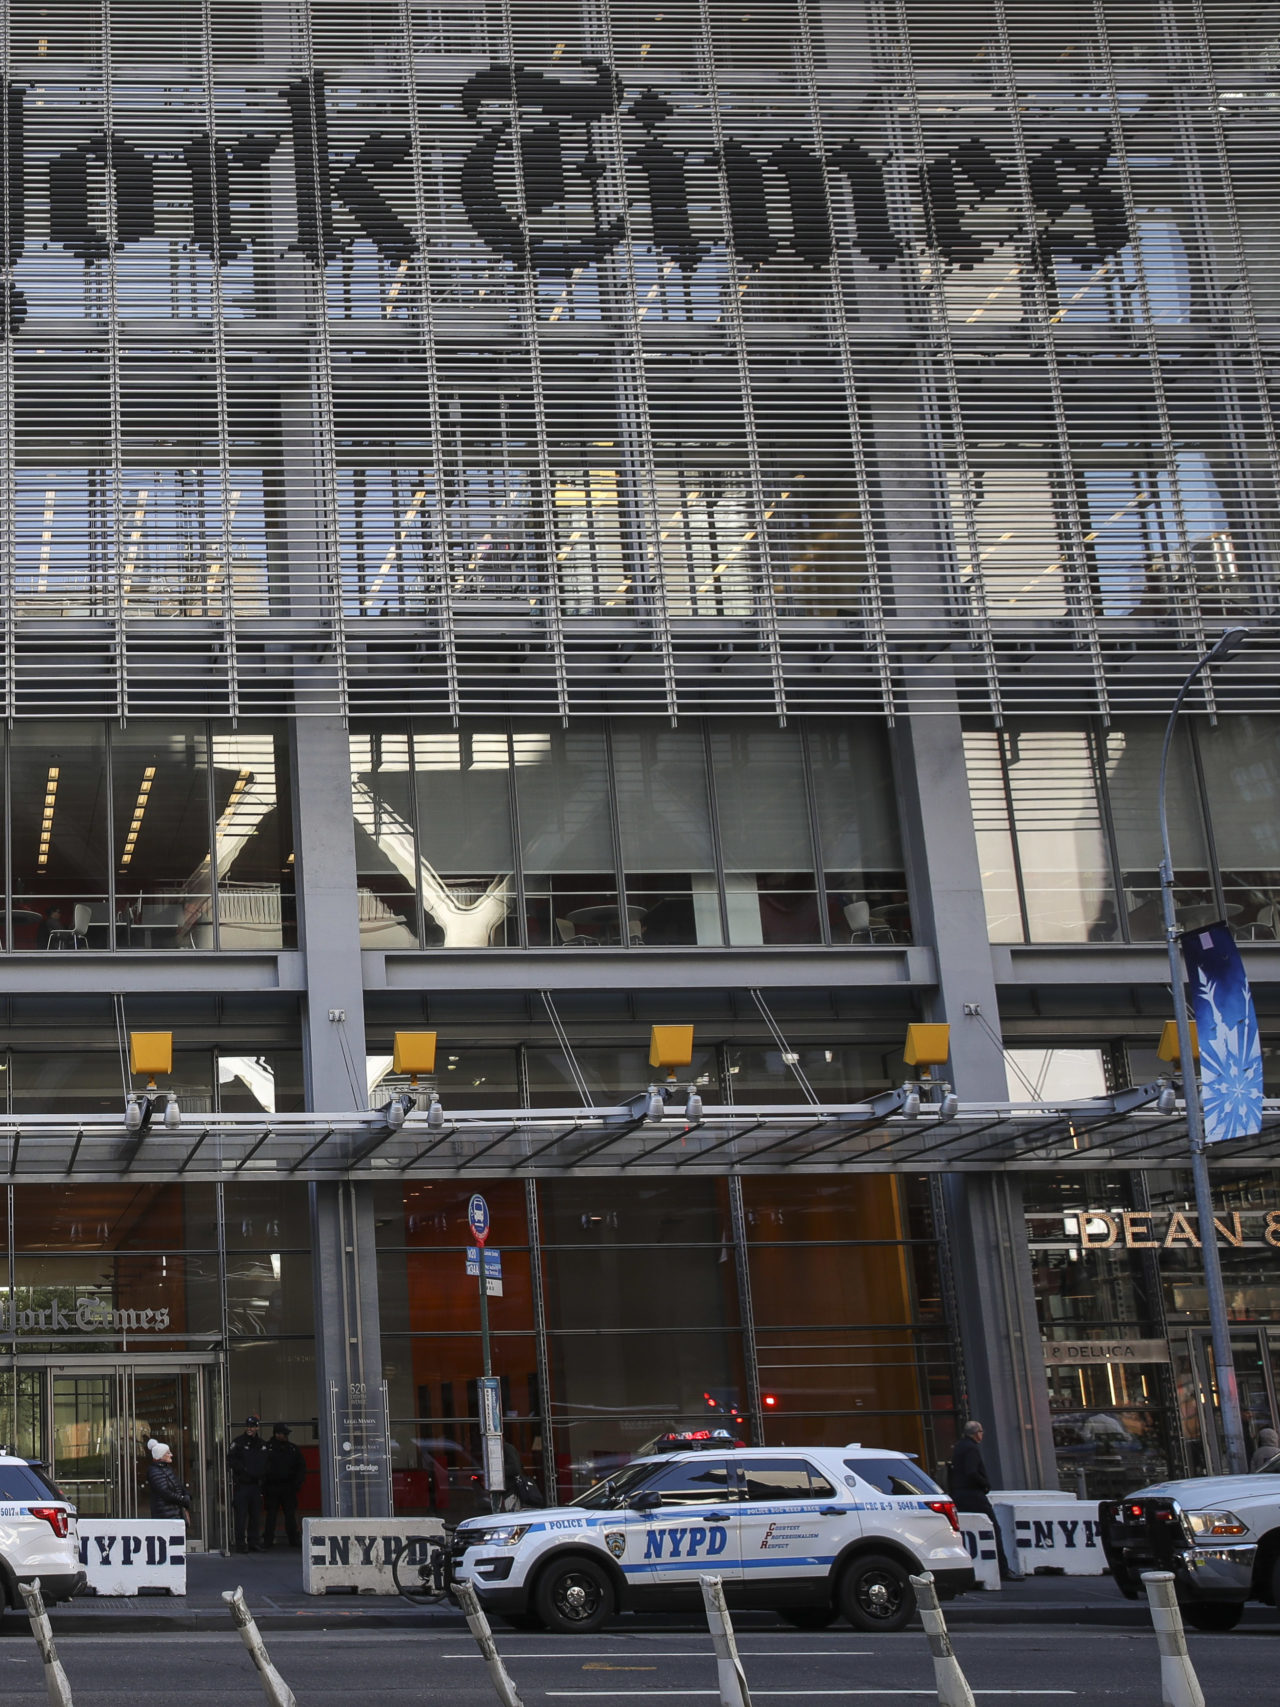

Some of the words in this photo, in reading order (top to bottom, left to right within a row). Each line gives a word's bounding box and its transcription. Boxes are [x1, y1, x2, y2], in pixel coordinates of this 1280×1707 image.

[460, 57, 1132, 288] Times
[1078, 1211, 1244, 1249] DEAN
[75, 1297, 171, 1332] Times
[1067, 1345, 1136, 1358] DELUCA
[350, 1383, 366, 1394] 620
[345, 1464, 379, 1472] ClearBridge
[0, 1507, 15, 1517] 5017
[550, 1519, 583, 1530] POLICE
[643, 1525, 728, 1560] NYPD
[1033, 1520, 1102, 1548] NYP
[328, 1535, 429, 1566] NYPD
